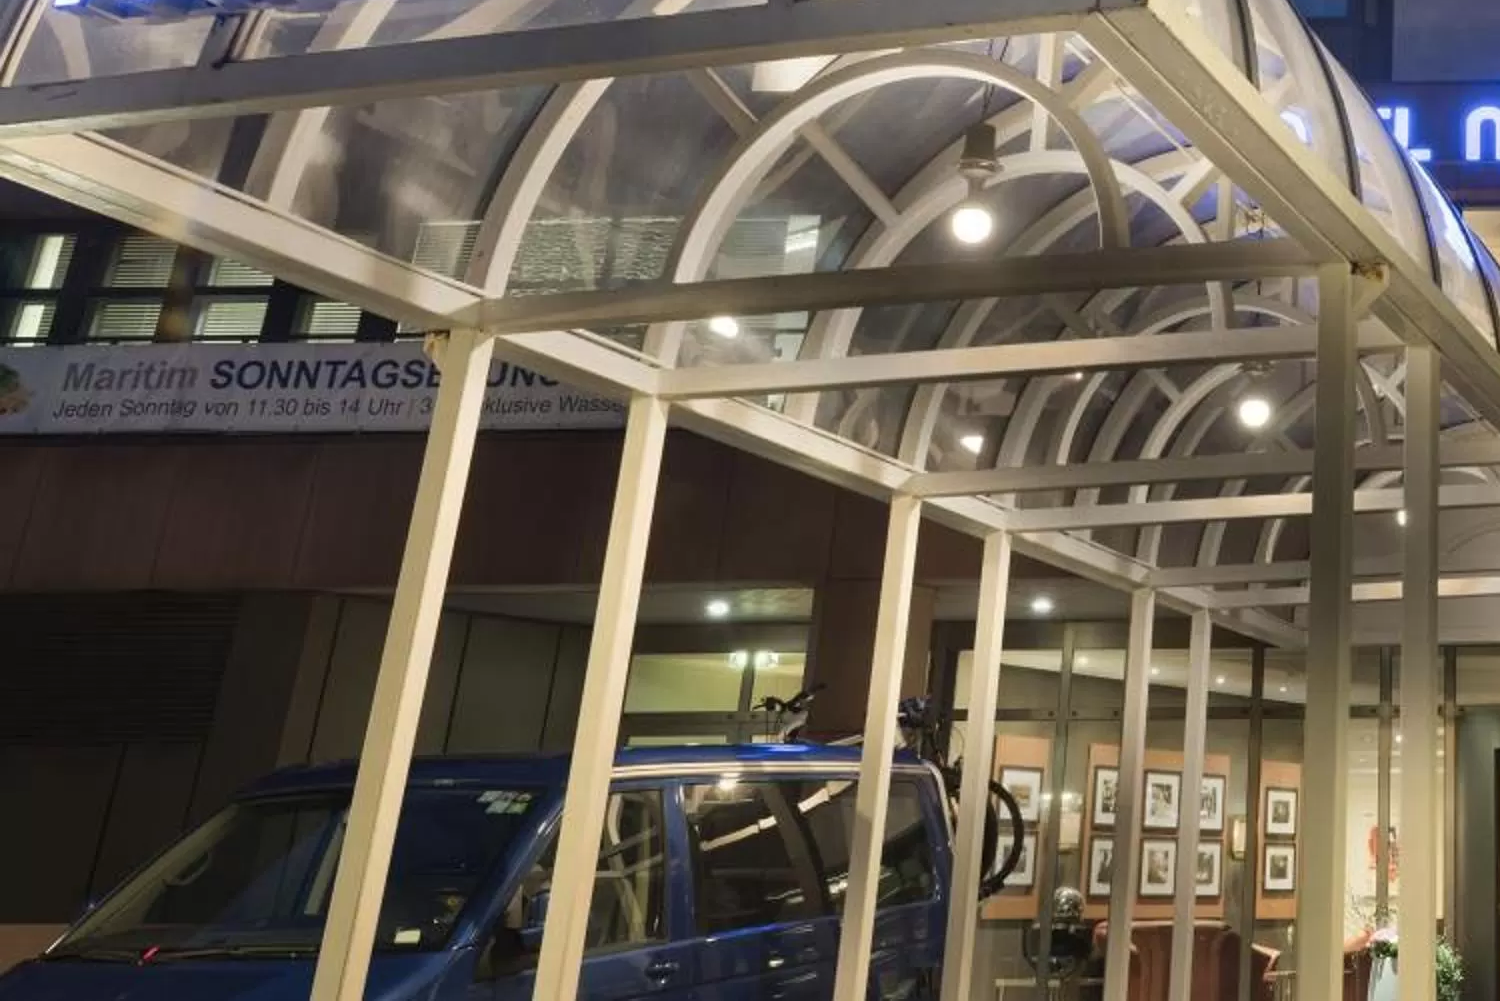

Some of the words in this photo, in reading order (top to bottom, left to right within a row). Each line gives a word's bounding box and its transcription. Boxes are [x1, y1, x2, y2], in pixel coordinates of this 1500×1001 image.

[62, 361, 198, 392] Maritim
[52, 399, 113, 420] Jeden
[118, 399, 197, 419] Sonntag
[204, 402, 238, 416] von
[249, 399, 298, 417] 11.30
[303, 398, 331, 417] bis
[340, 399, 361, 416] 14
[367, 399, 402, 417] Uhr
